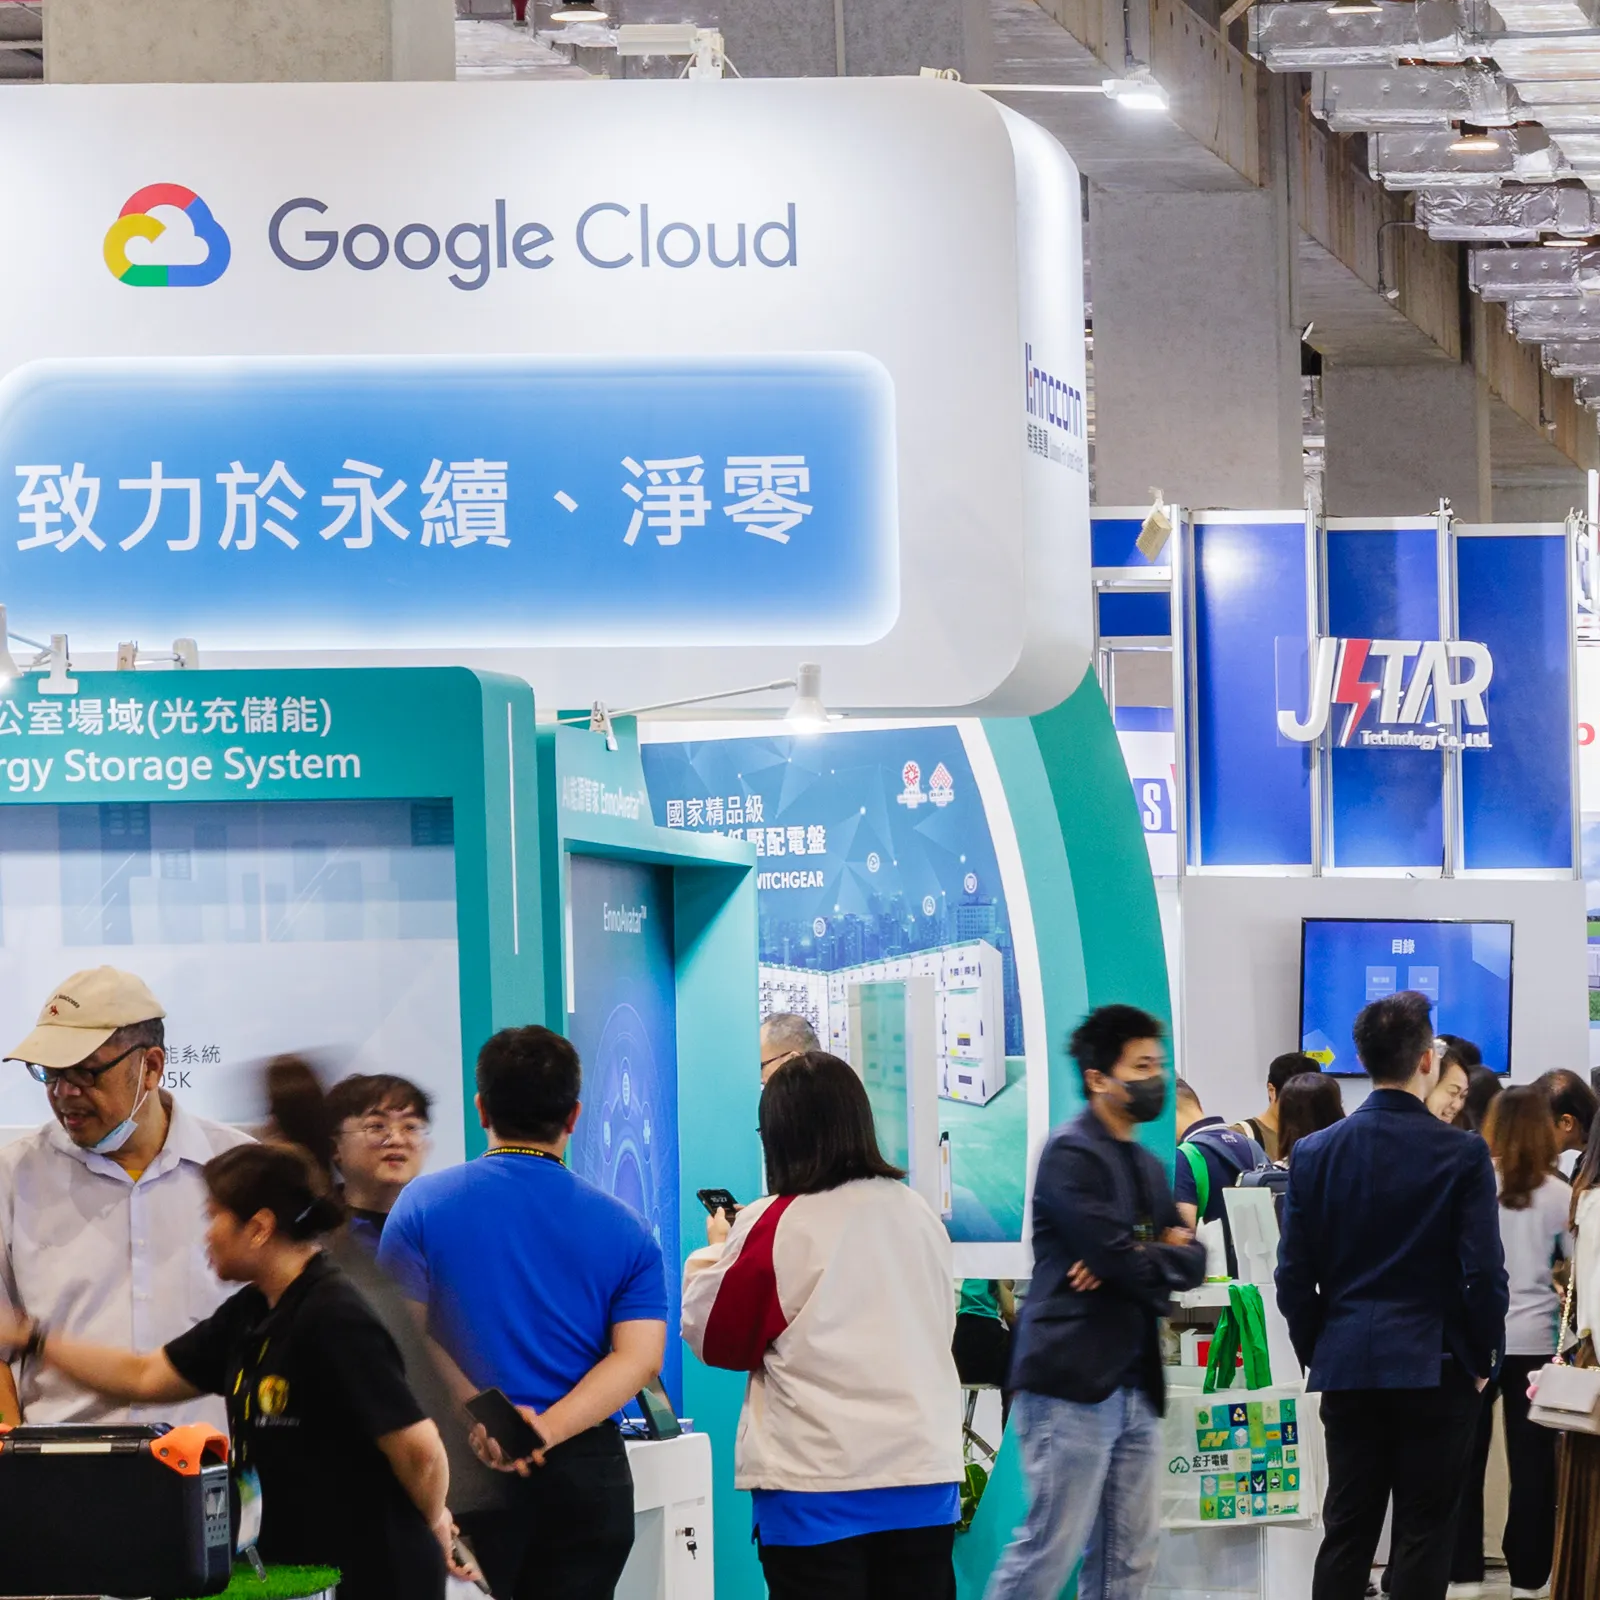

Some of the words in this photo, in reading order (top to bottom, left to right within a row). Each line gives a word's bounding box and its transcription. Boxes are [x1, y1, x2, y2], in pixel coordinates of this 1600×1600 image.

[267, 196, 555, 291] Google
[574, 202, 799, 270] Cloud
[14, 454, 814, 553] 致力於永續、淨零
[1360, 730, 1438, 750] Technology
[64, 750, 213, 791] Storage
[223, 747, 361, 790] System
[666, 794, 765, 828] 國家精品級
[161, 1071, 192, 1089] 5K
